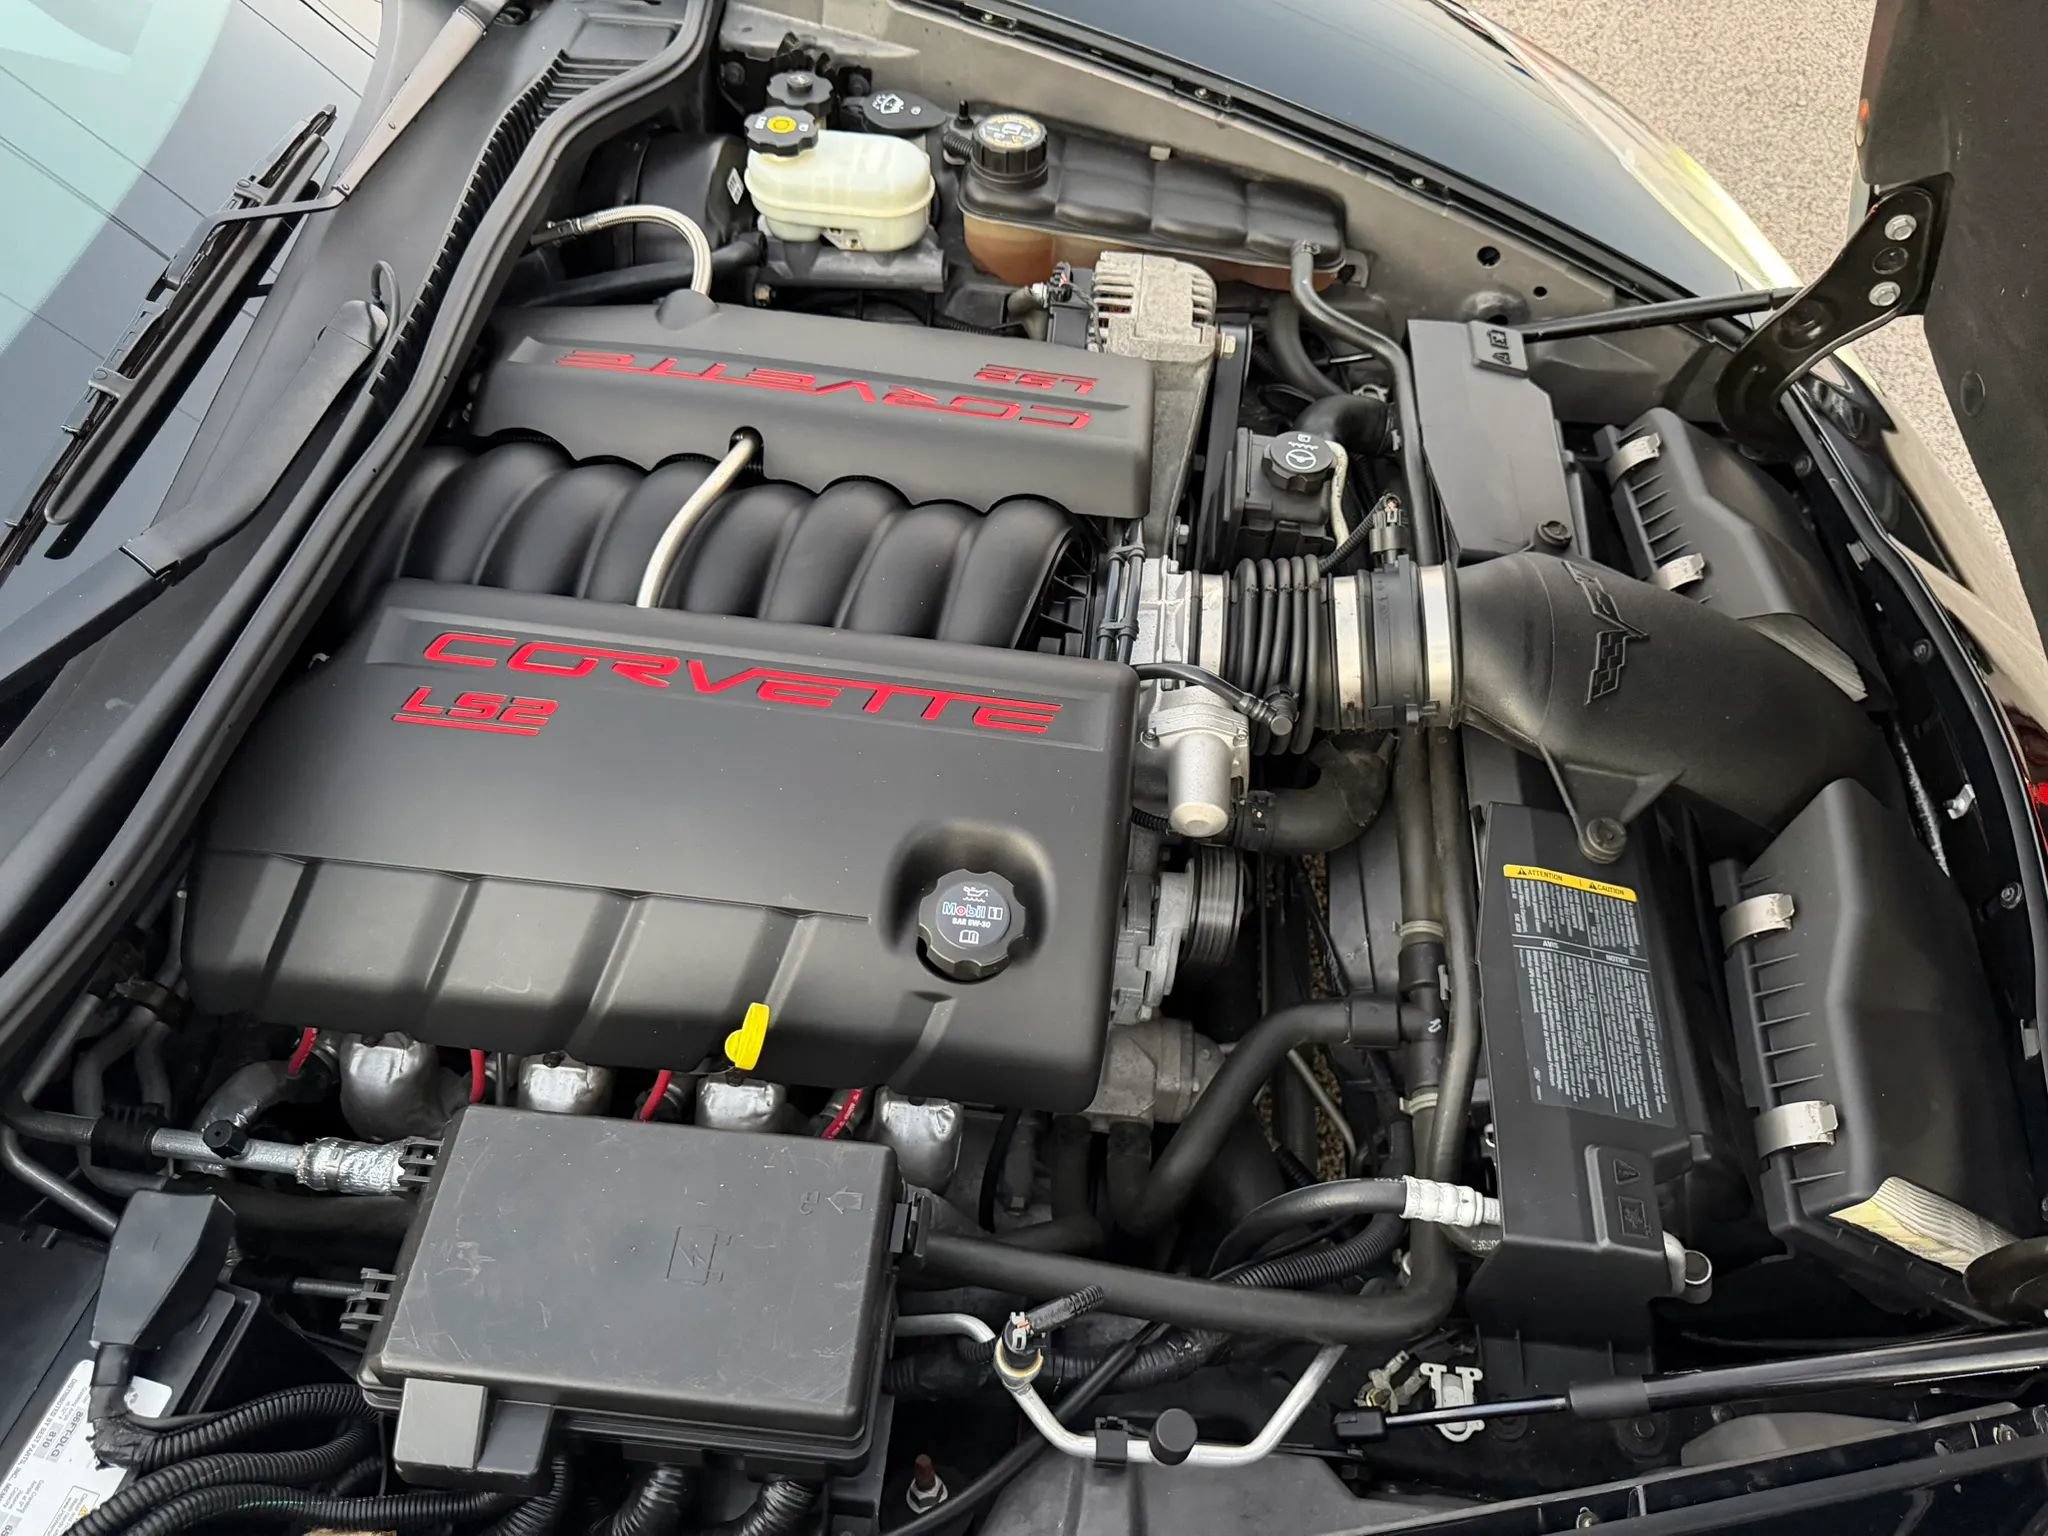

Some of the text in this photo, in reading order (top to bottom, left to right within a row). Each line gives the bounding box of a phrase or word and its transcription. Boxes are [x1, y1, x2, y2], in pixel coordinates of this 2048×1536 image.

[555, 350, 1091, 430] CORVETTE
[974, 364, 1098, 394] LS2
[423, 631, 1063, 733] CORVETTE
[395, 686, 559, 733] LS2
[1527, 868, 1625, 896] ATTENTION CAUTION
[942, 901, 986, 918] Mobil
[1606, 954, 1629, 965] NOTICE
[42, 1431, 57, 1448] 810
[50, 1410, 84, 1458] 86FT-DLG
